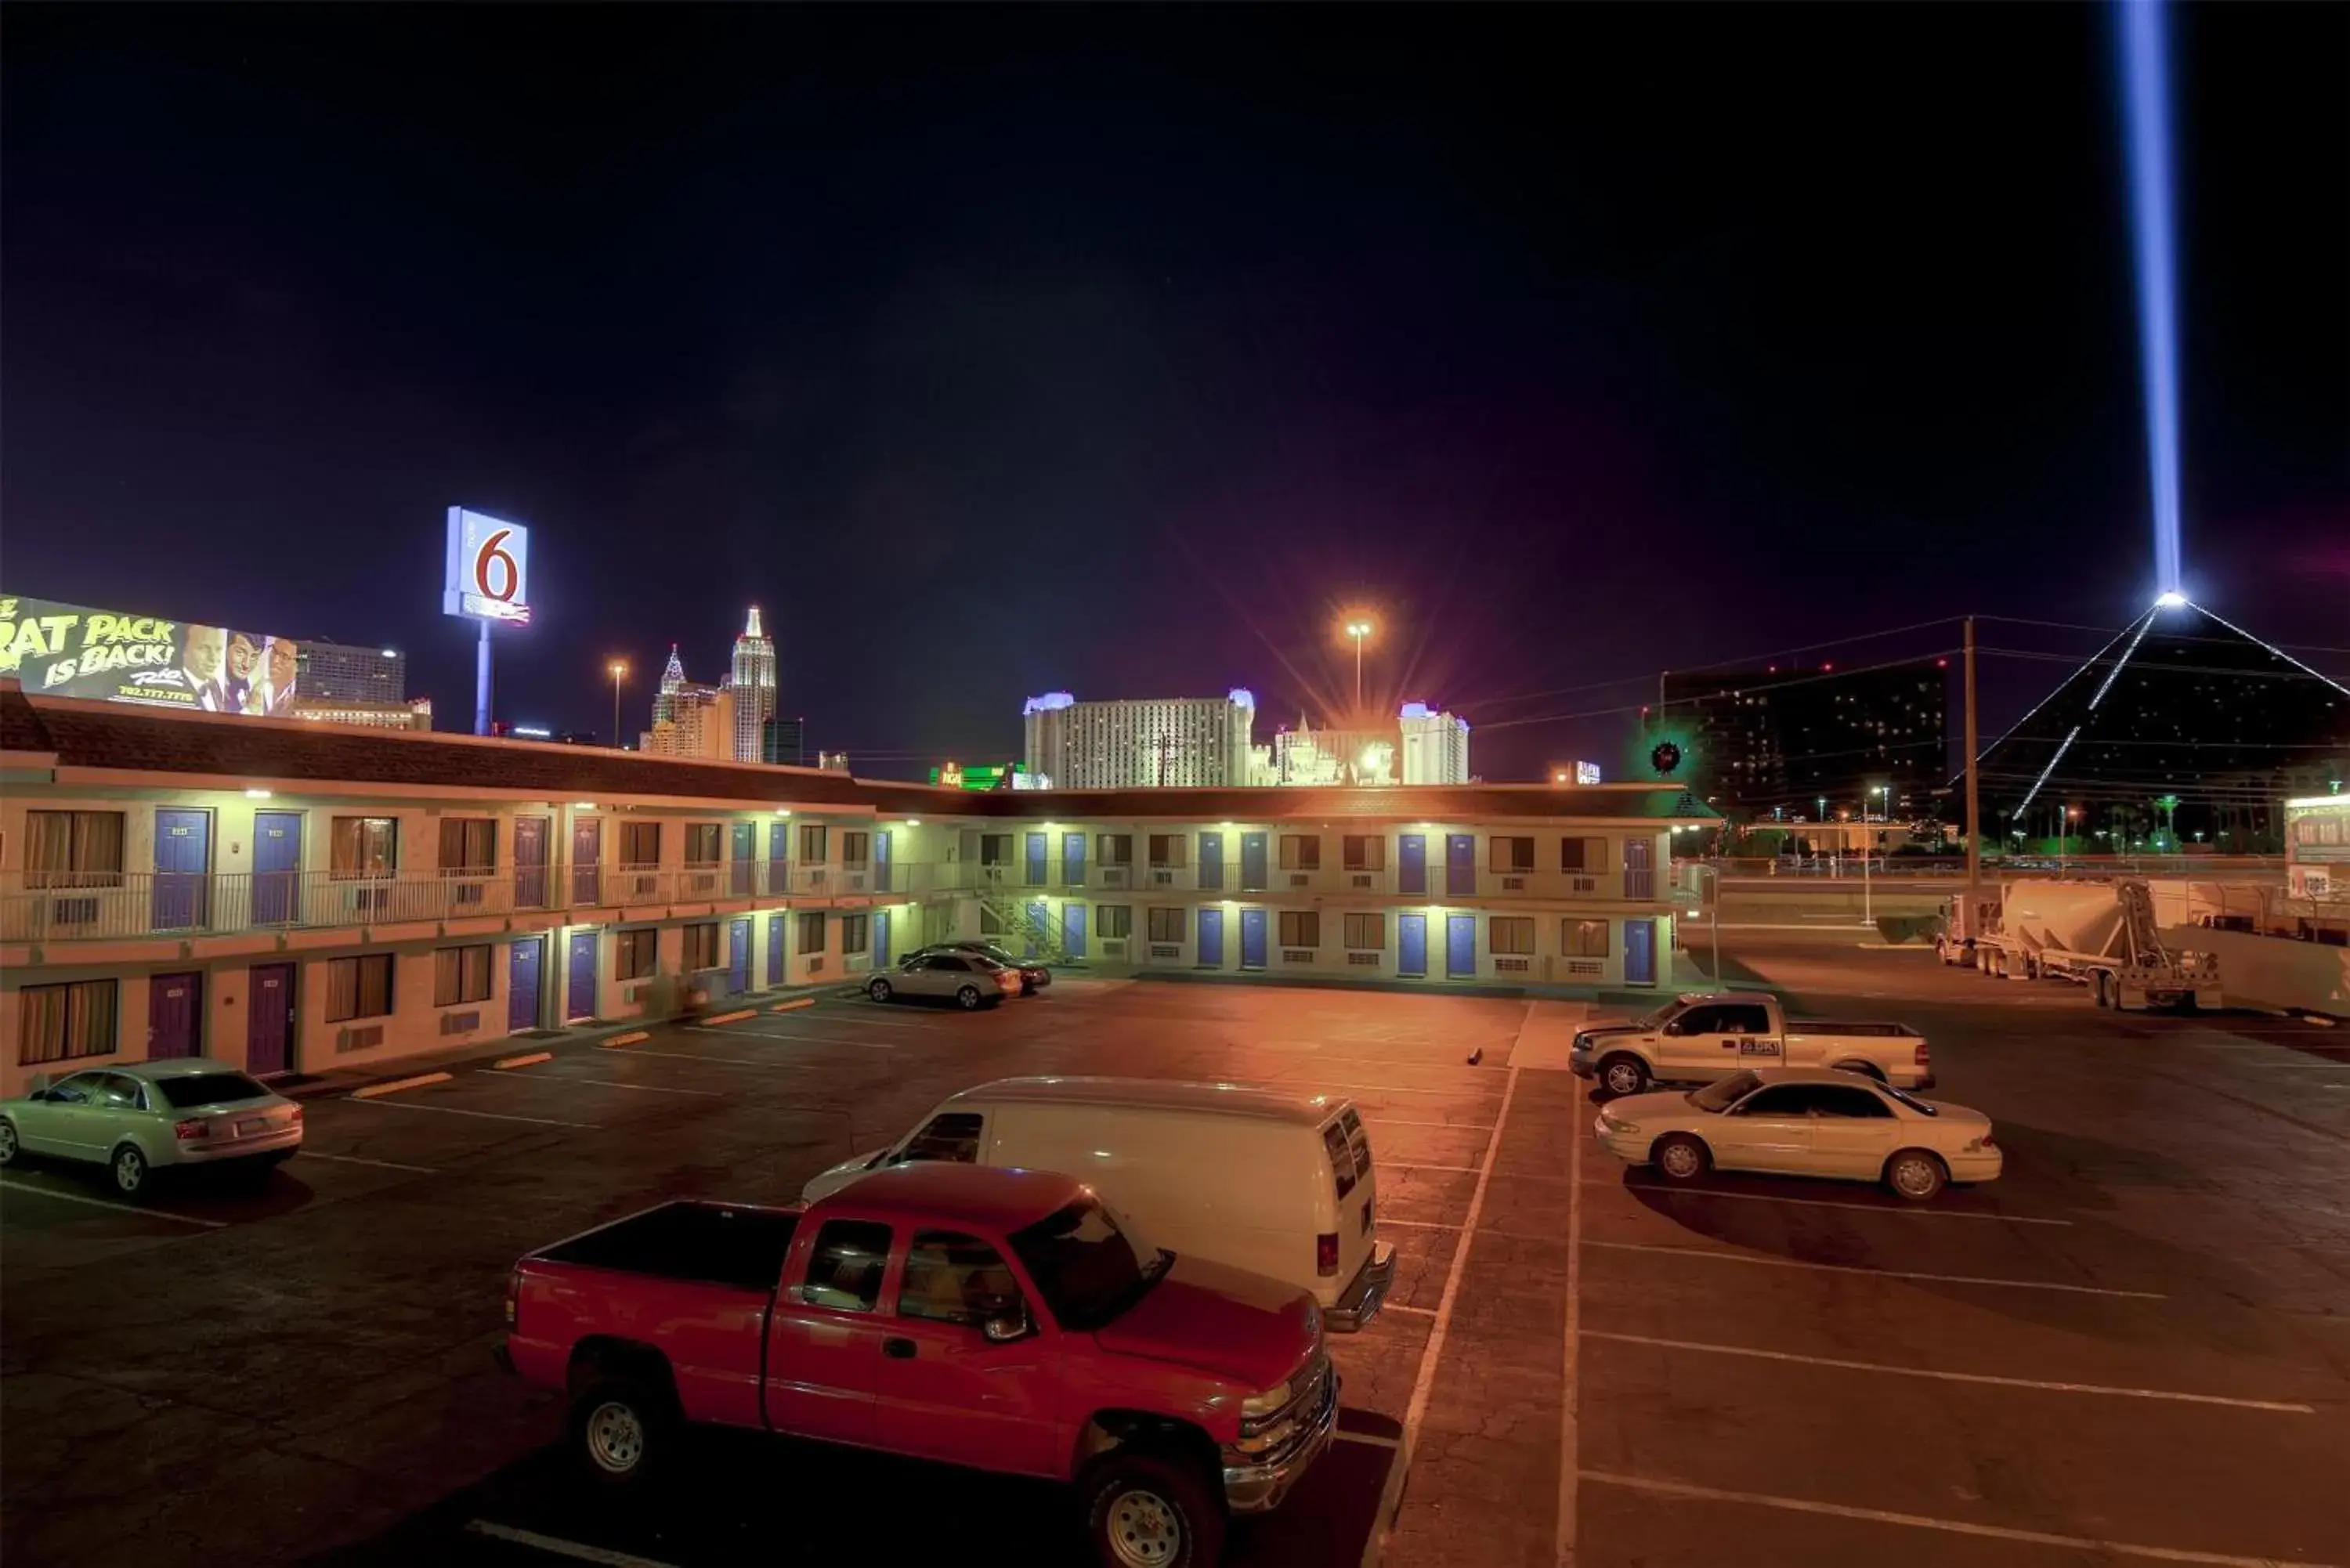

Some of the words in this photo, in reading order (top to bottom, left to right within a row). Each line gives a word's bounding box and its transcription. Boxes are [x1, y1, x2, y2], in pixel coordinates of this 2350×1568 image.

[473, 528, 519, 602] 6
[81, 615, 175, 647] PACK
[42, 659, 78, 688] IS
[80, 644, 175, 676] BACK!
